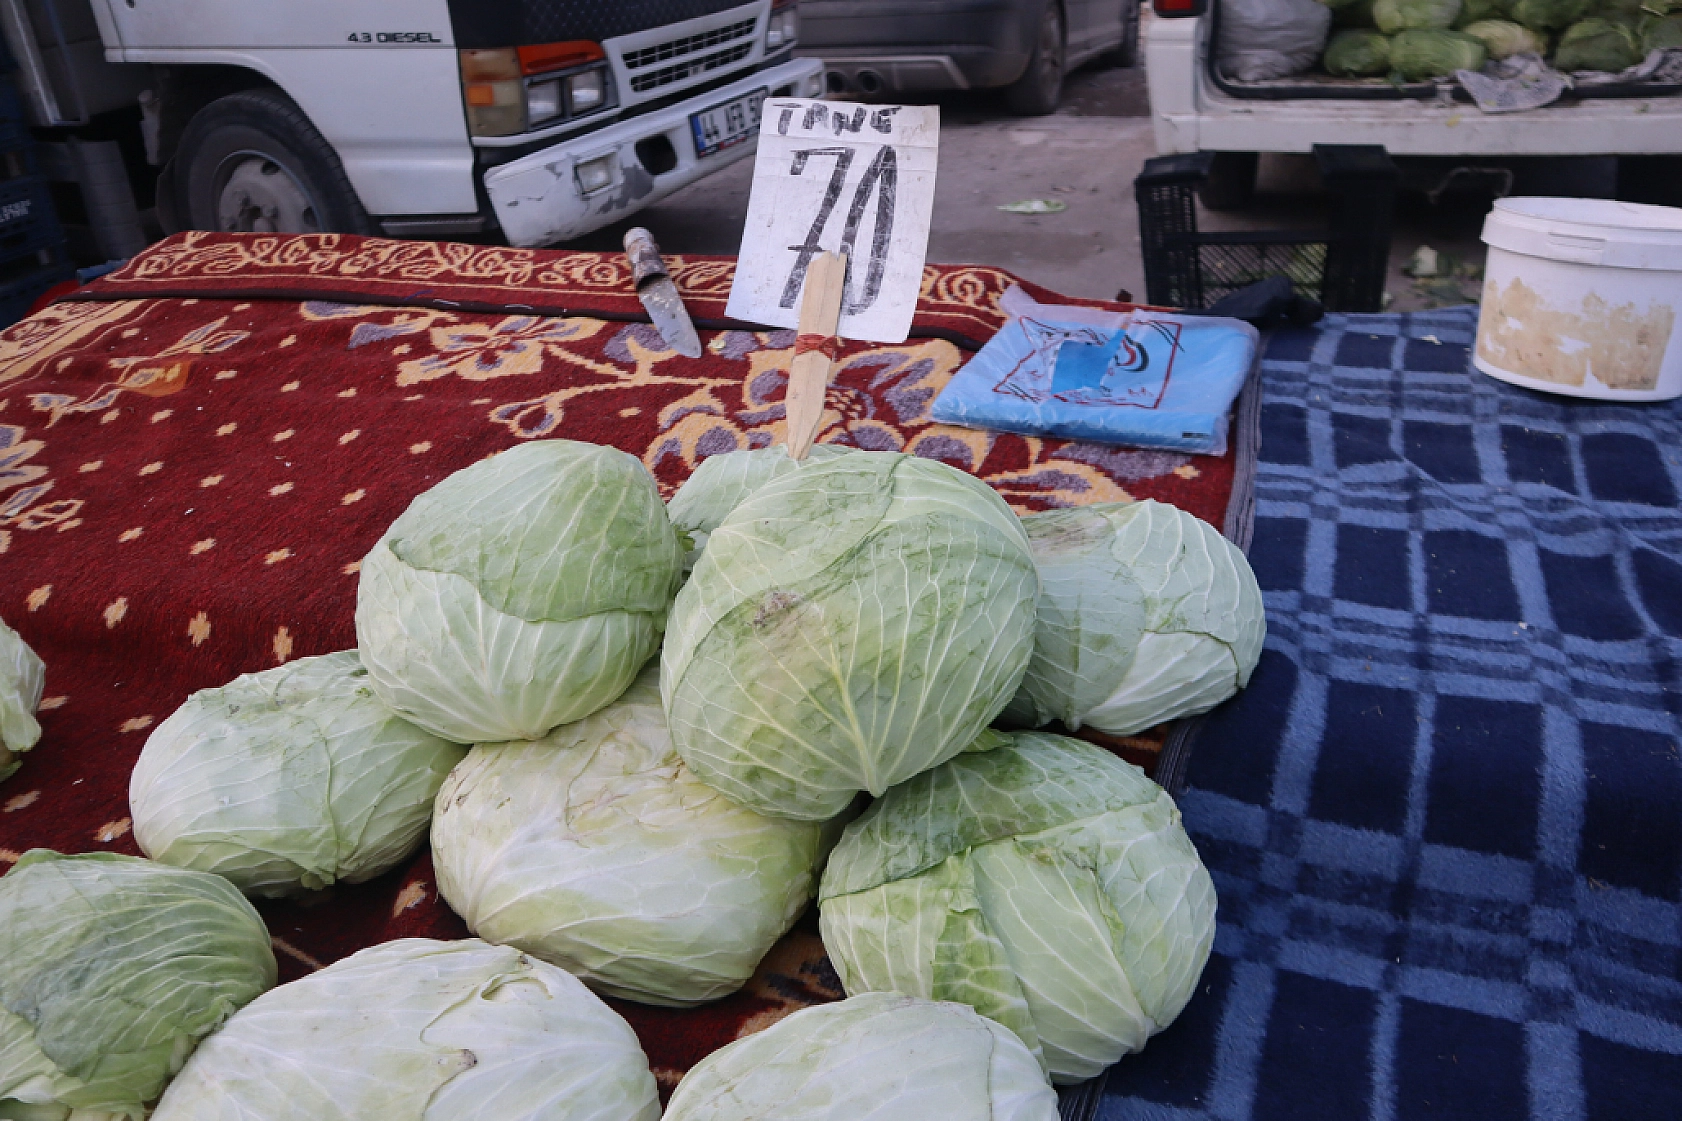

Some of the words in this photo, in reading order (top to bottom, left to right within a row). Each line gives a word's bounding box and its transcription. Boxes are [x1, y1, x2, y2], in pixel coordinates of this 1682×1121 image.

[376, 32, 442, 43] DIESEL
[773, 102, 902, 136] TANE
[778, 144, 898, 316] 70
